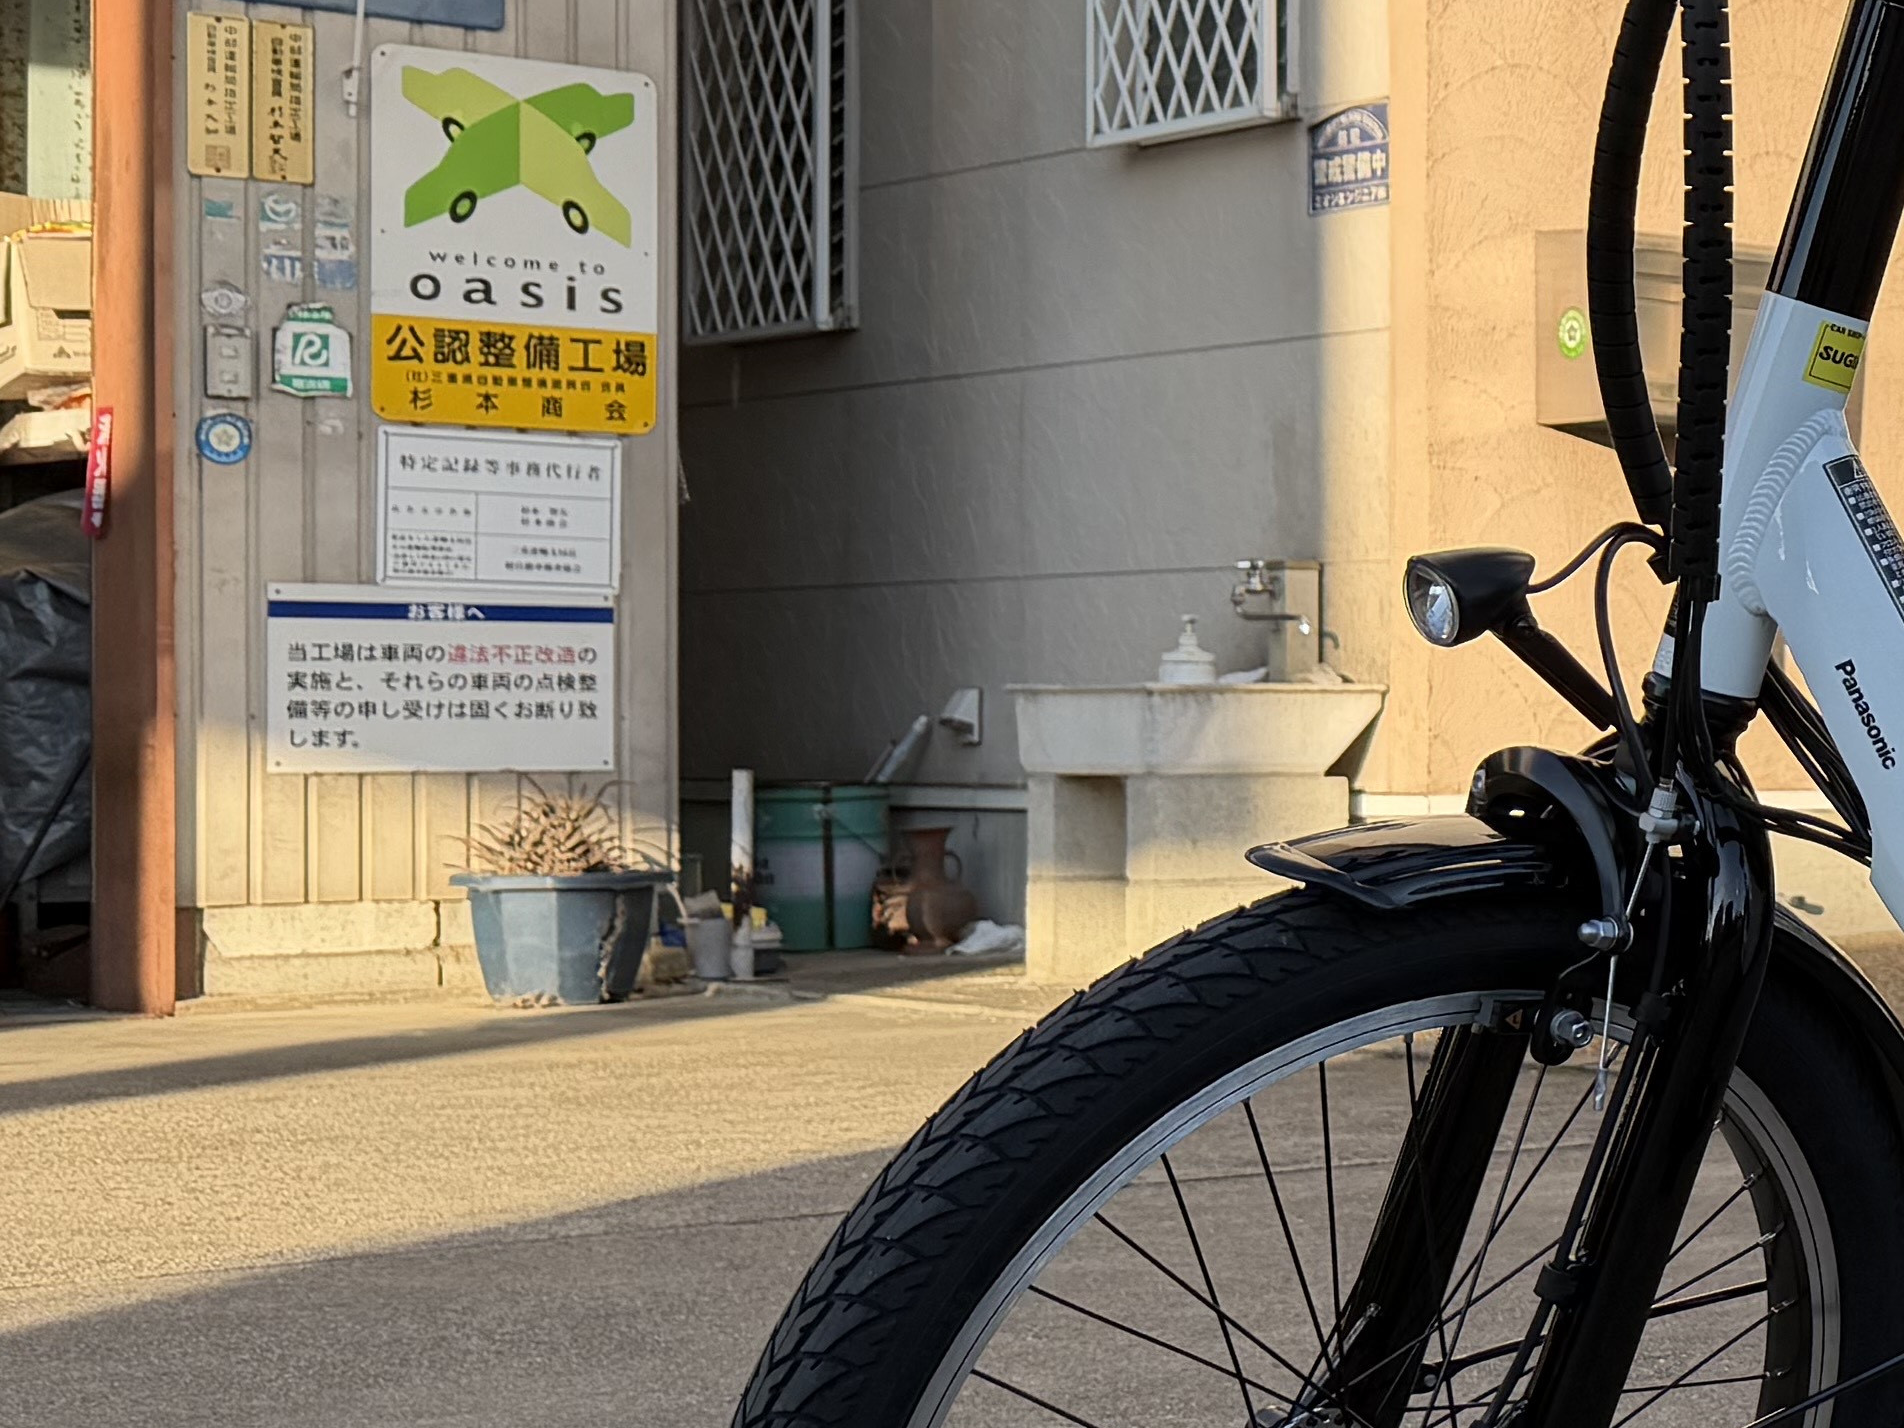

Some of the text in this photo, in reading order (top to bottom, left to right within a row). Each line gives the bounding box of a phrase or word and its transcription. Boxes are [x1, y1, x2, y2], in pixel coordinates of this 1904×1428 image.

[429, 250, 606, 276] welcome to
[409, 273, 623, 314] oasis
[386, 323, 648, 378] 公認整備工場
[409, 386, 628, 422] 杉本商会
[407, 603, 486, 621] お客様へ
[287, 642, 597, 665] 当工場は車両の違法不正改造の
[287, 671, 597, 692] 実施と、それらの車両の点検整
[1834, 658, 1896, 771] Panasonic
[290, 730, 361, 749] します。
